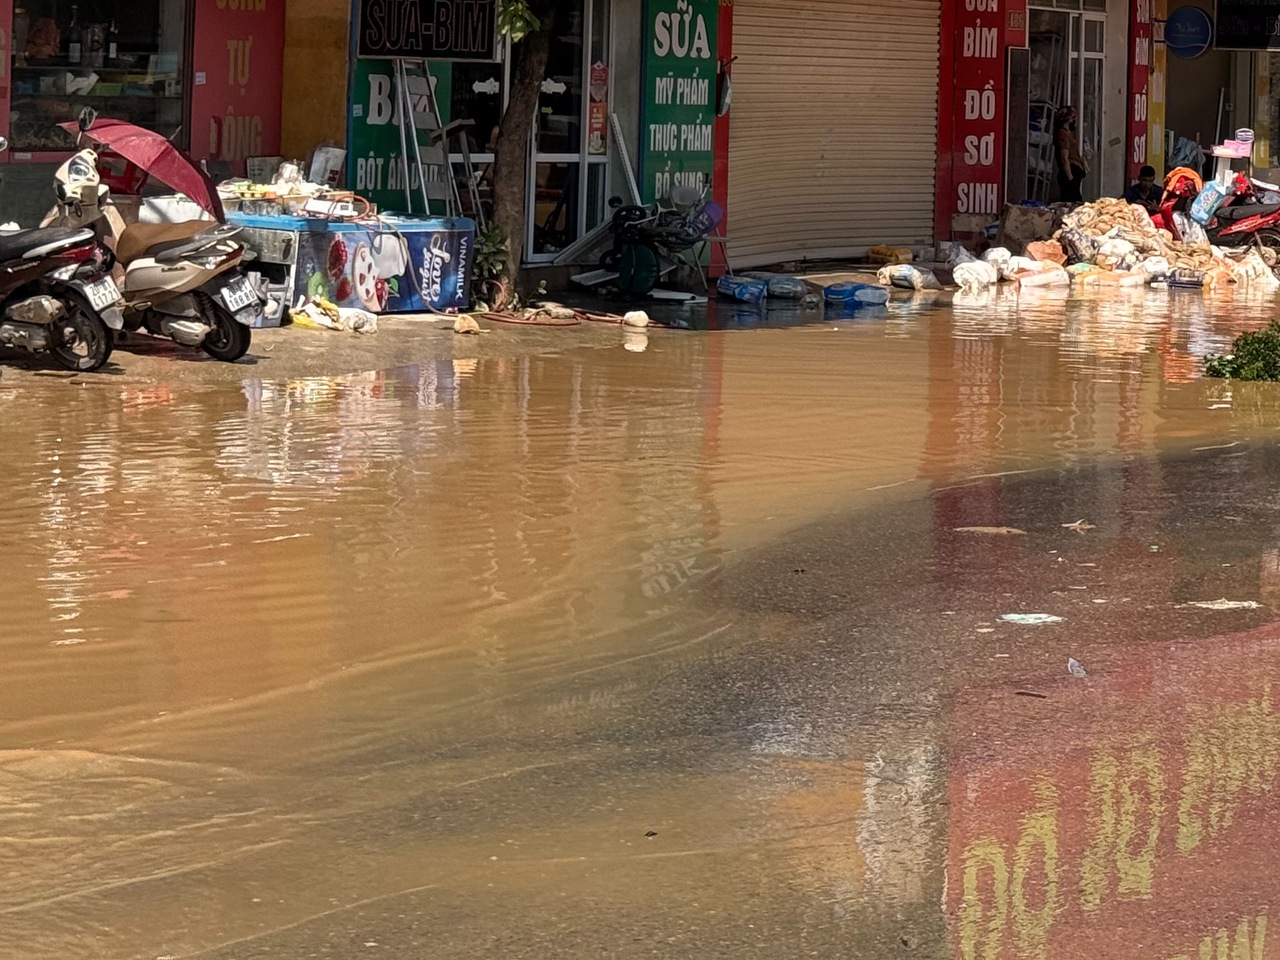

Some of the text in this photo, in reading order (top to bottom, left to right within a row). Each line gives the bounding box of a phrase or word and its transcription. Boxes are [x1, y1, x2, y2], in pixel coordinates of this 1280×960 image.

[654, 0, 711, 59] SỮA
[963, 19, 998, 59] BỈM
[227, 35, 253, 96] TỰ
[656, 67, 709, 106] MỸ PHẨM
[964, 79, 995, 121] ĐỒ
[650, 113, 712, 157] THỰC PHẨM
[964, 132, 995, 166] SƠ
[1134, 133, 1146, 164] SƠ
[357, 151, 384, 198] BỘT
[655, 160, 670, 200] BỔ
[957, 182, 998, 215] SINH
[419, 247, 432, 302] yogurt
[455, 236, 468, 301] VINAMILK
